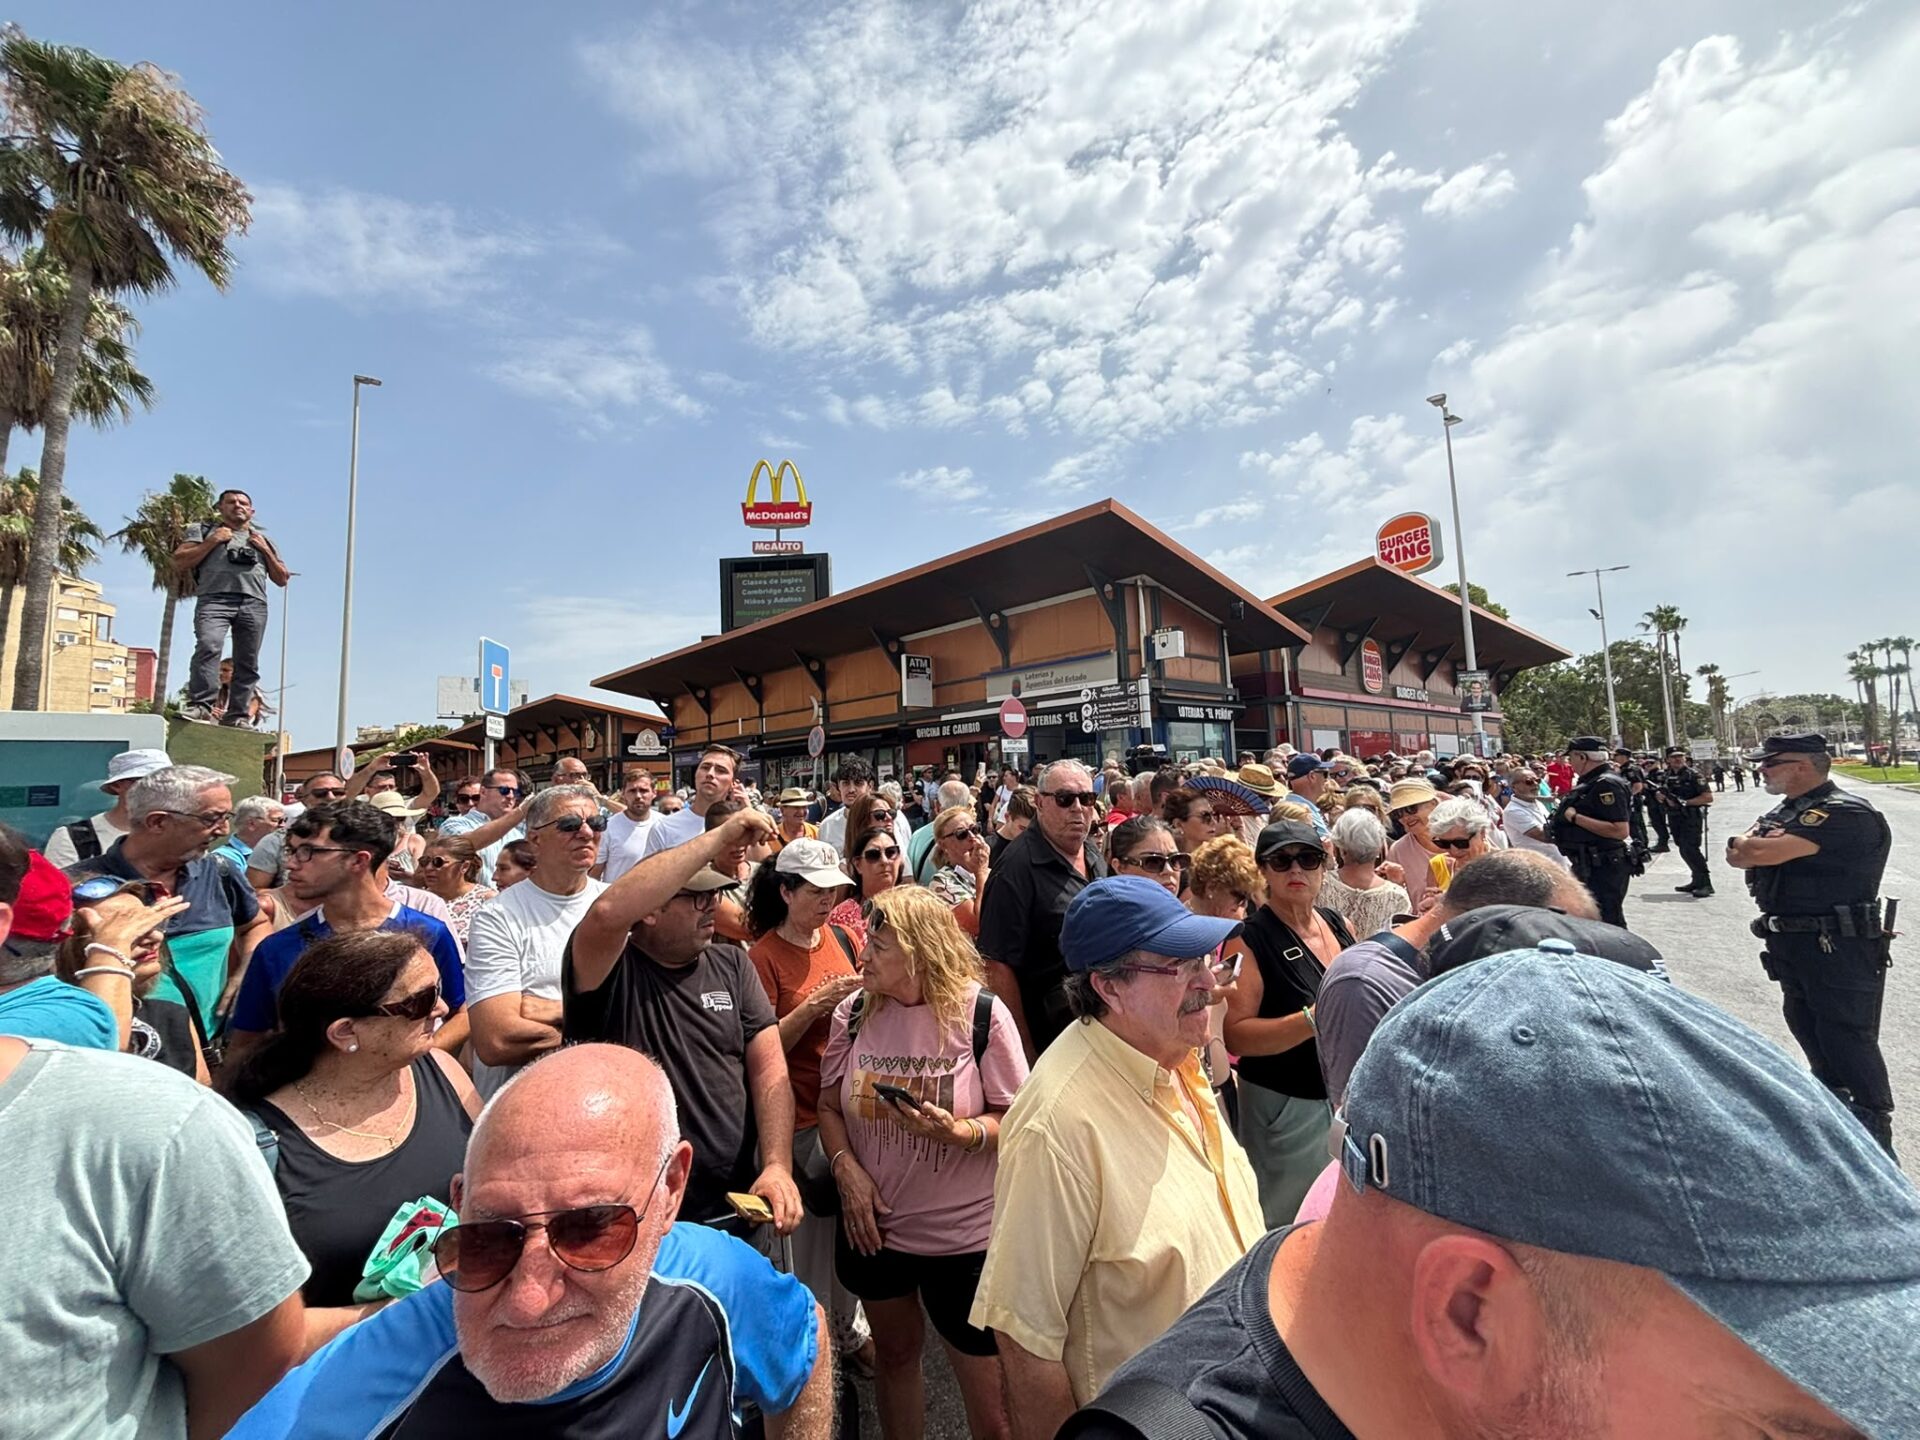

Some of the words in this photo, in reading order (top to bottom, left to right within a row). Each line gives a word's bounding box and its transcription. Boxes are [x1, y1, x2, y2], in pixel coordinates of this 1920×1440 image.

[745, 511, 808, 520] McDonald's
[1380, 527, 1429, 551] BURGER
[755, 543, 801, 551] McAUTO
[1380, 539, 1431, 565] KING
[741, 588, 782, 596] Cambridge
[909, 658, 928, 668] ATM
[1065, 673, 1087, 682] Estado
[1178, 706, 1205, 719] LOTERIAS
[1026, 713, 1063, 727] LOTERIAS
[916, 727, 941, 739] OFICINA
[941, 725, 951, 736] DE
[952, 721, 981, 735] CAMBIO
